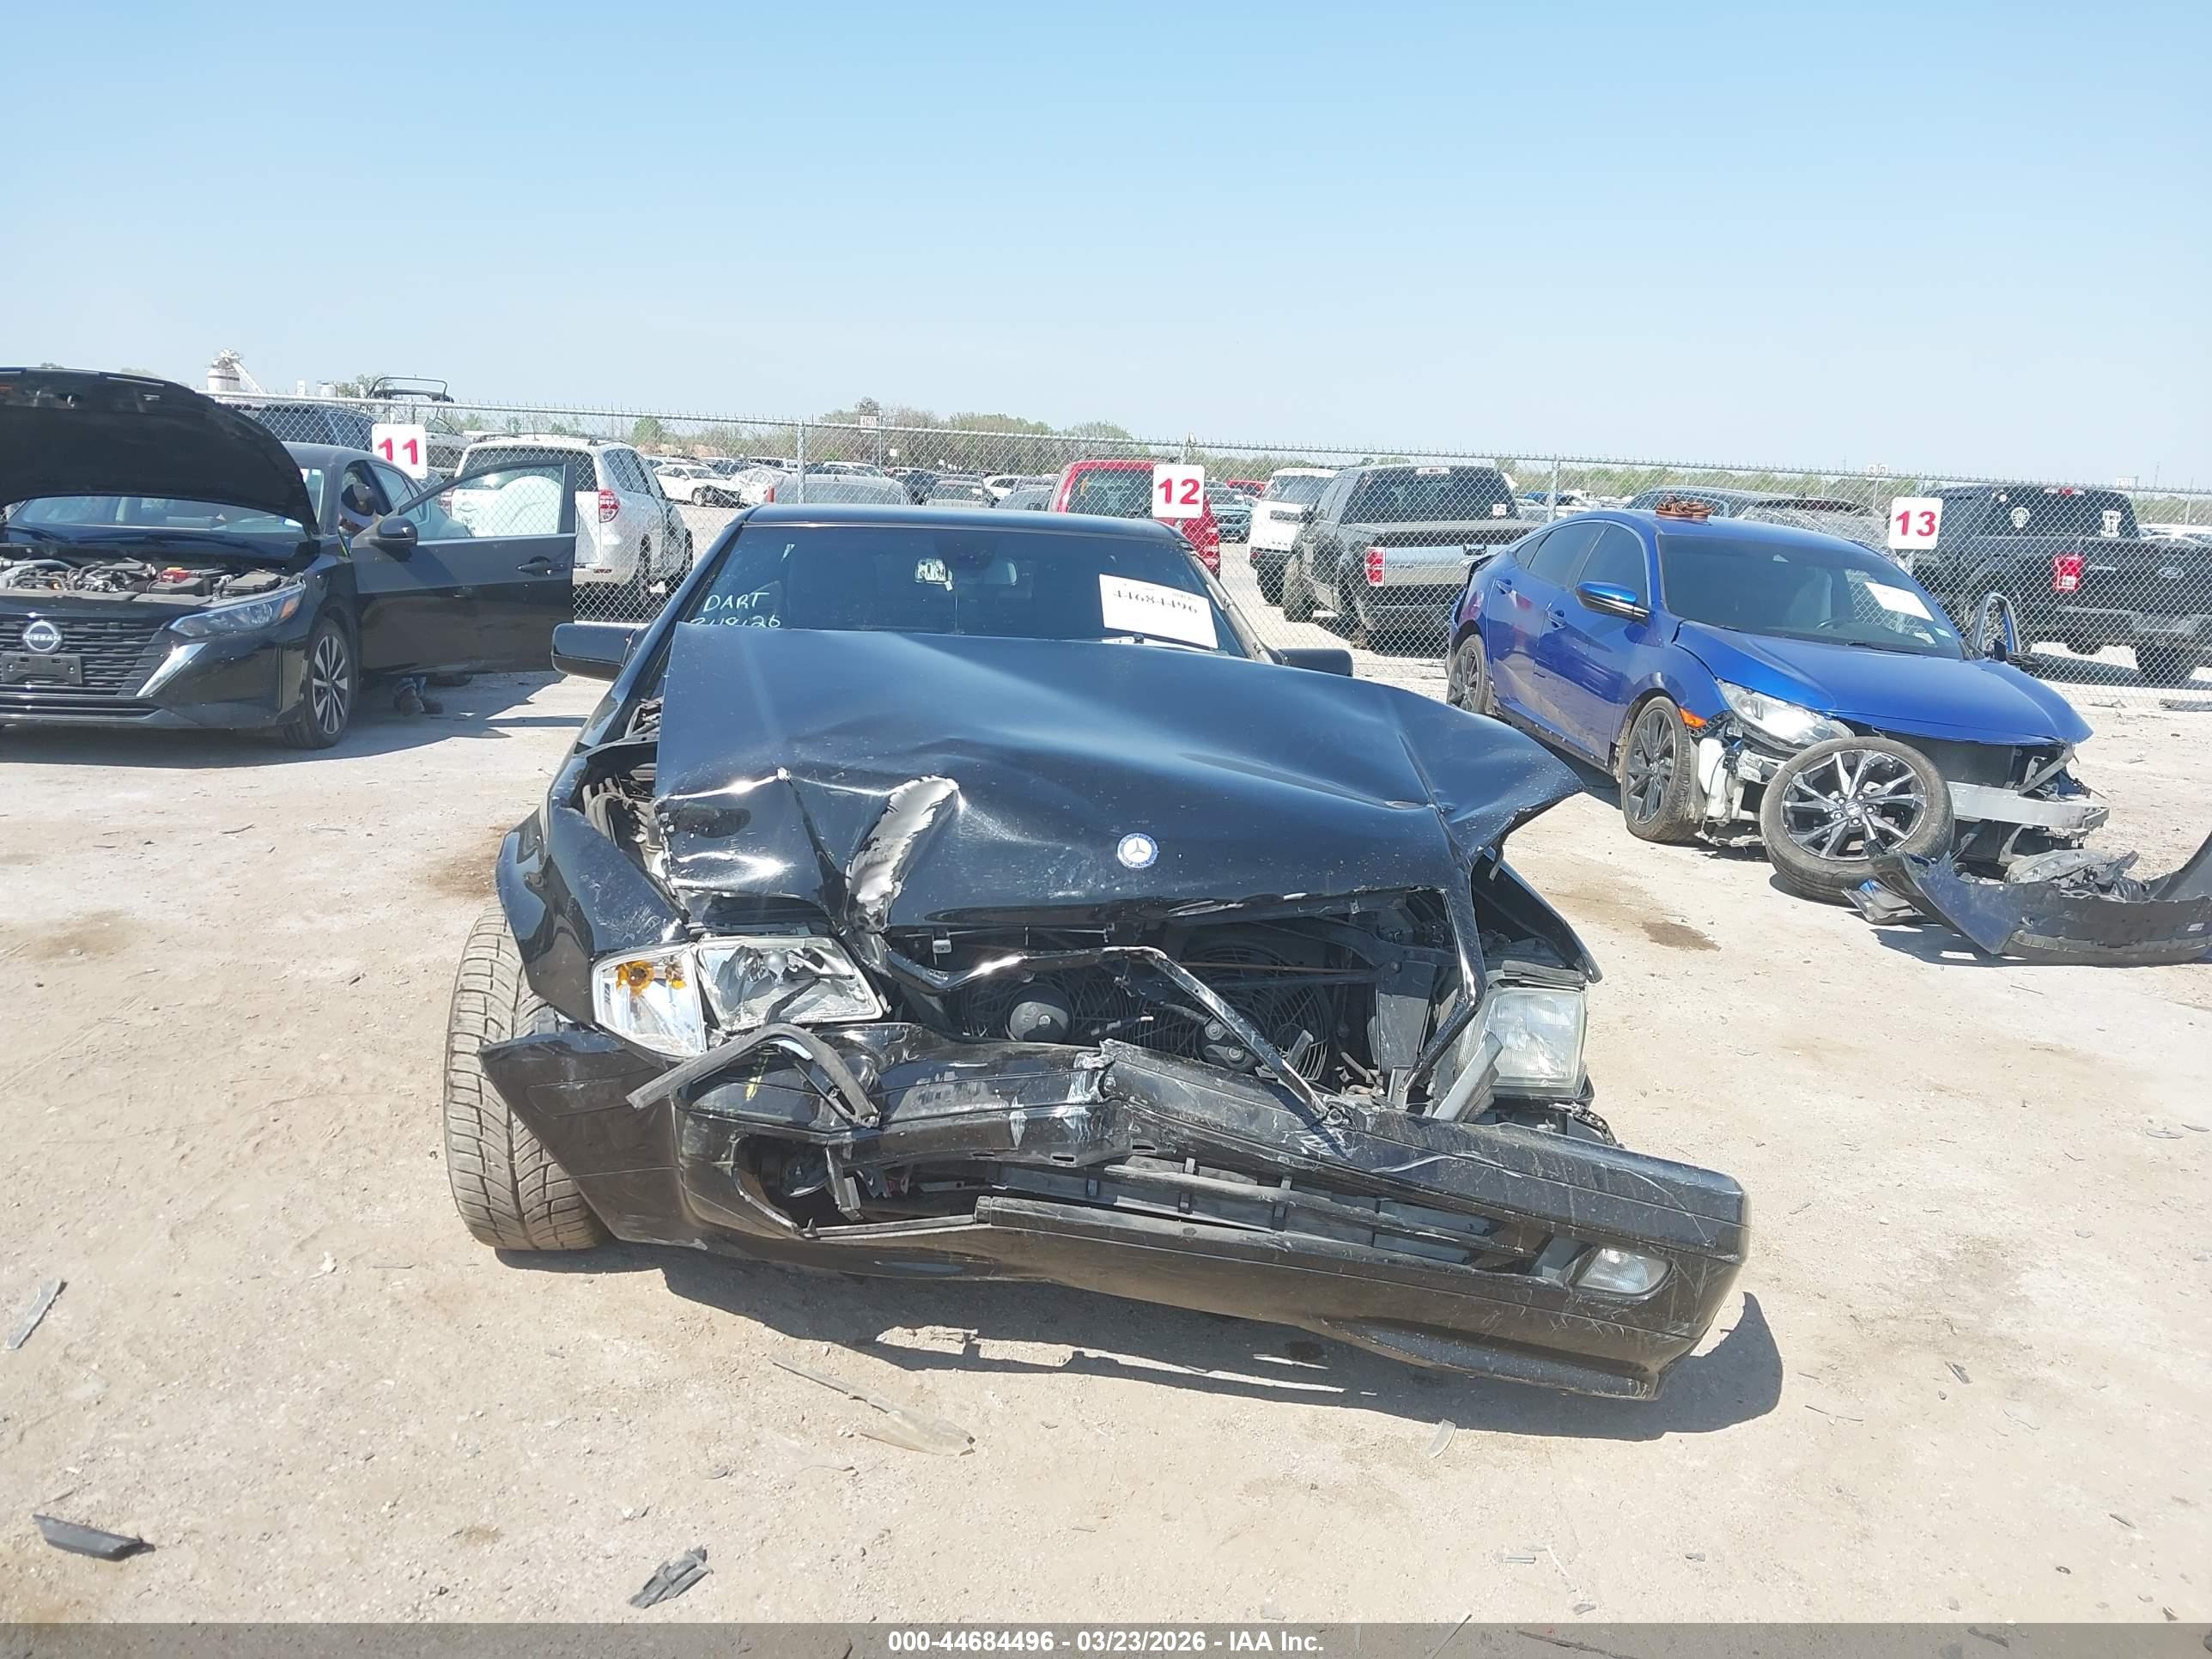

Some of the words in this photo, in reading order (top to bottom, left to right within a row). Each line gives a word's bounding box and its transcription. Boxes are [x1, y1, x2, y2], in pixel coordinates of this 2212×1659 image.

[378, 437, 418, 465] 11
[1158, 477, 1200, 505] 12
[1895, 510, 1936, 537] 13
[702, 592, 770, 612] DART
